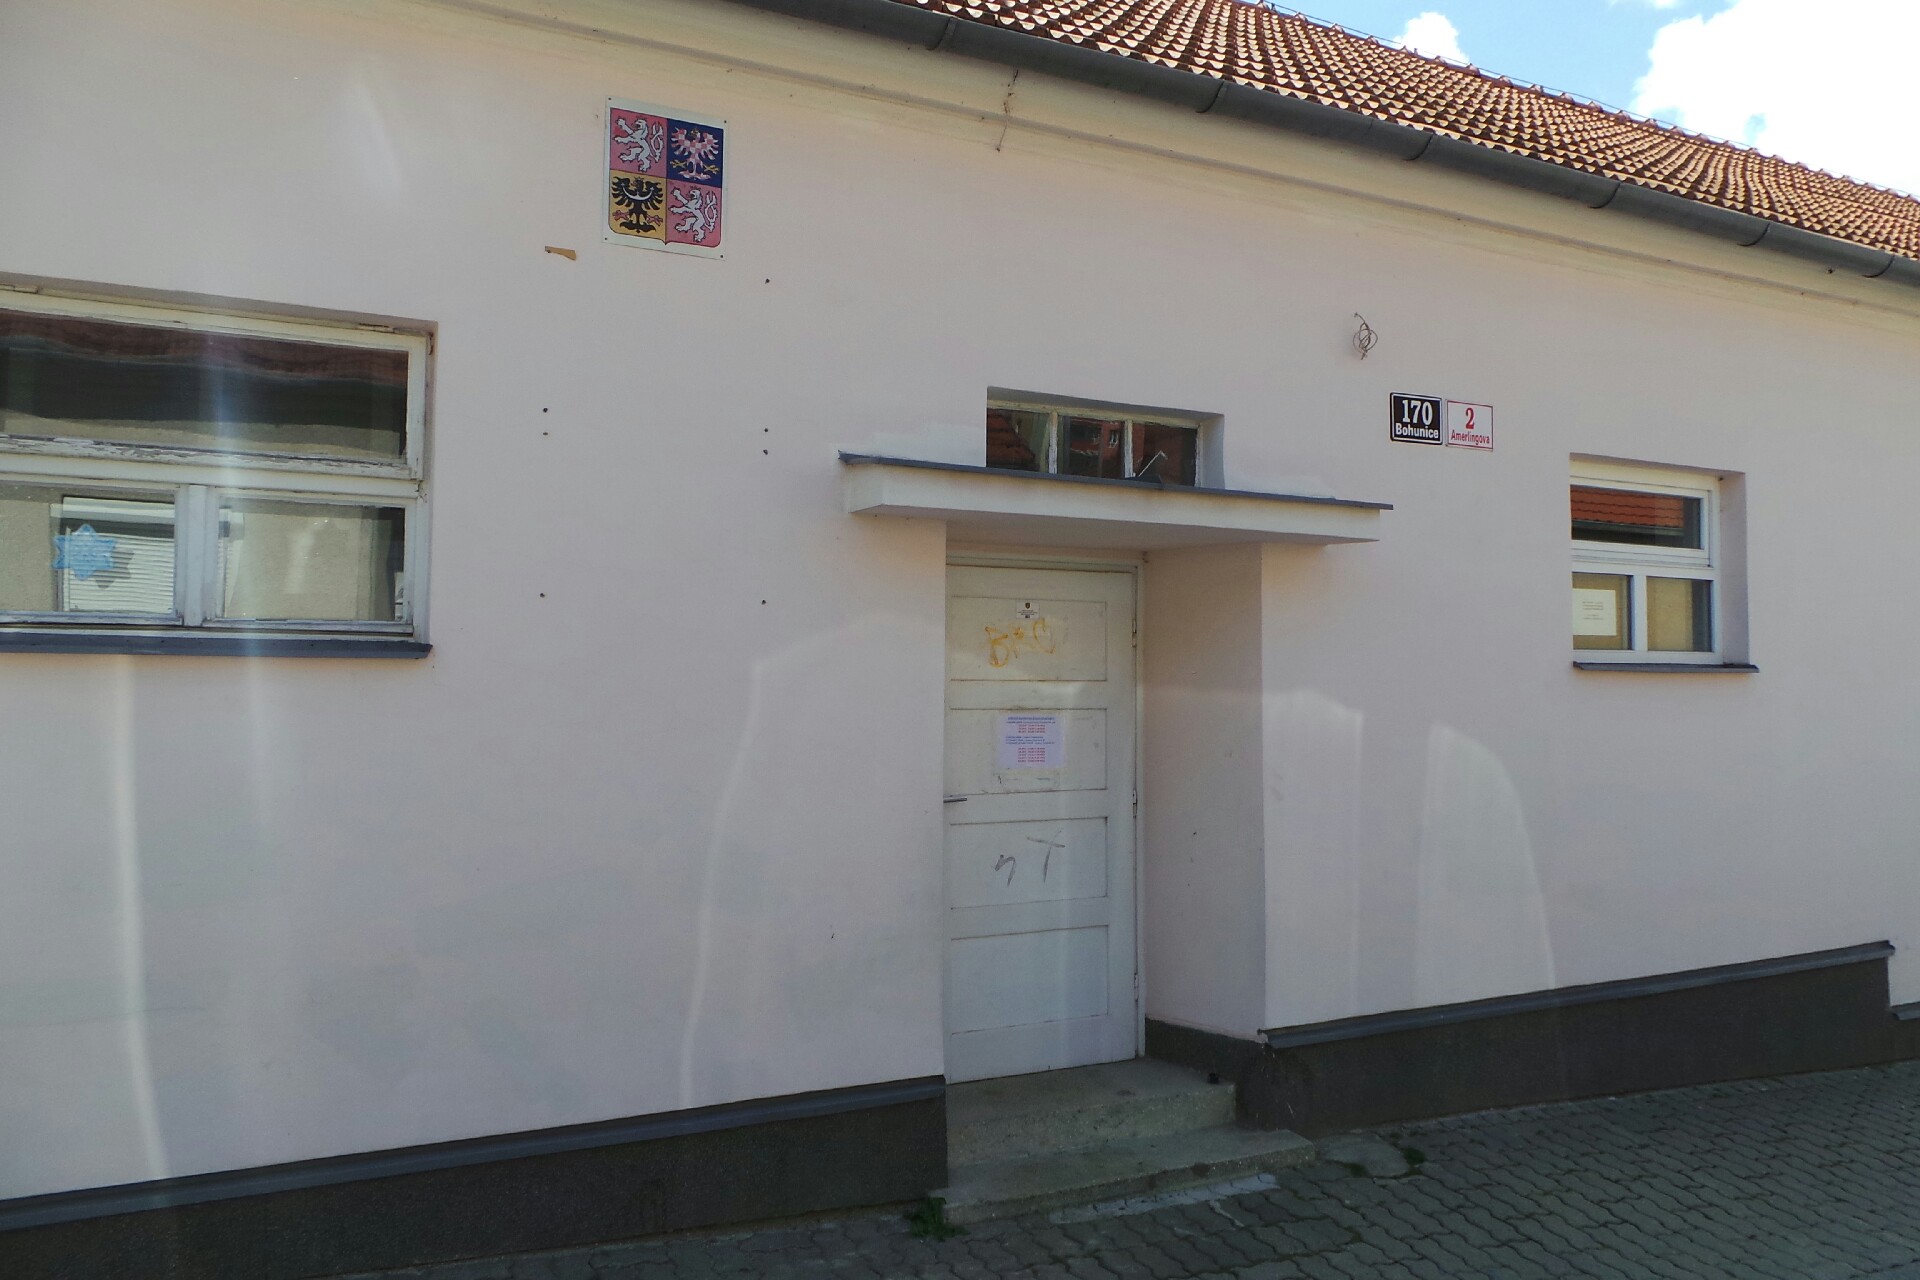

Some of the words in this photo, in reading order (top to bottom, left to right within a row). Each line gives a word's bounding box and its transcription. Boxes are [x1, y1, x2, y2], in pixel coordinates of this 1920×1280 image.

[1402, 400, 1433, 425] 170
[1465, 407, 1475, 430] 2
[1395, 422, 1439, 439] Bohunice
[1451, 429, 1490, 445] Amerlingova
